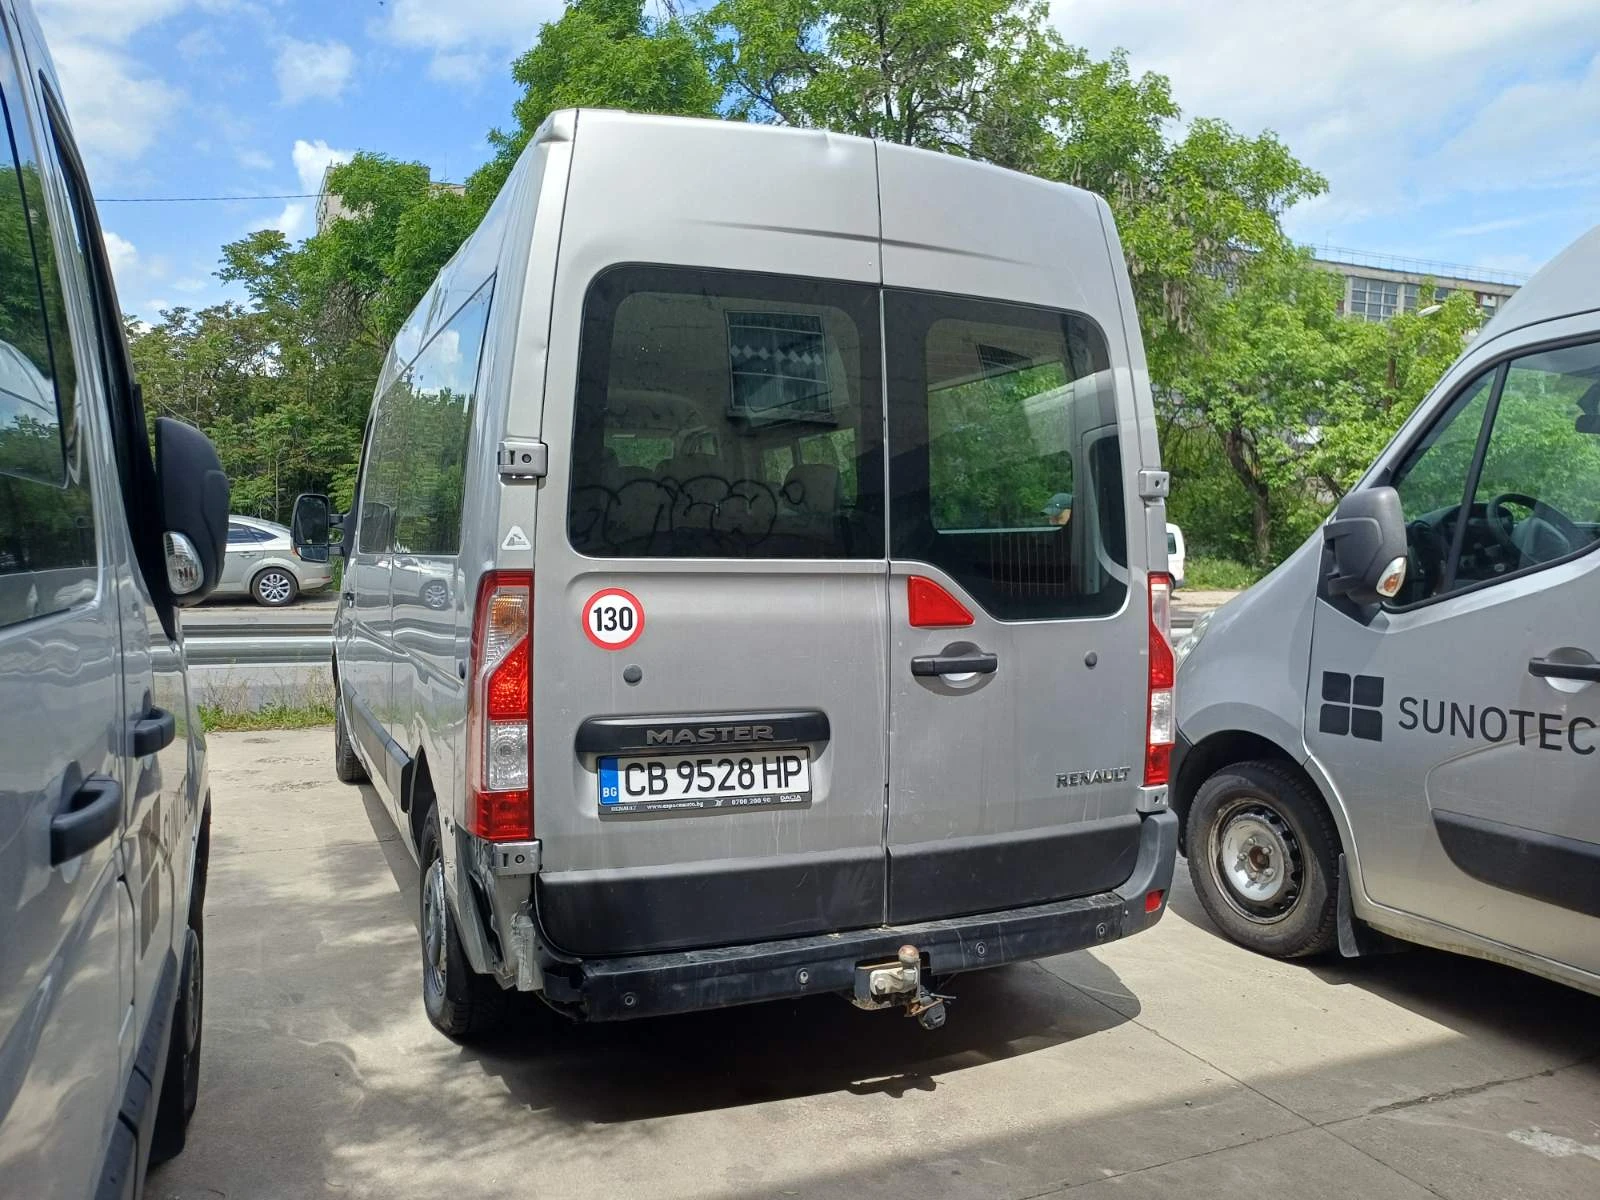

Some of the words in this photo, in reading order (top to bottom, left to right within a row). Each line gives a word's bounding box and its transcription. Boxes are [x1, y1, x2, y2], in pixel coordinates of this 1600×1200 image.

[593, 606, 633, 631] 130
[646, 725, 776, 746] MASTER
[1398, 696, 1597, 755] SUNOTEC
[624, 761, 669, 797] CB
[676, 757, 756, 794] 9528
[762, 755, 802, 789] HP
[1056, 766, 1131, 788] RENAULT
[602, 786, 618, 798] BG
